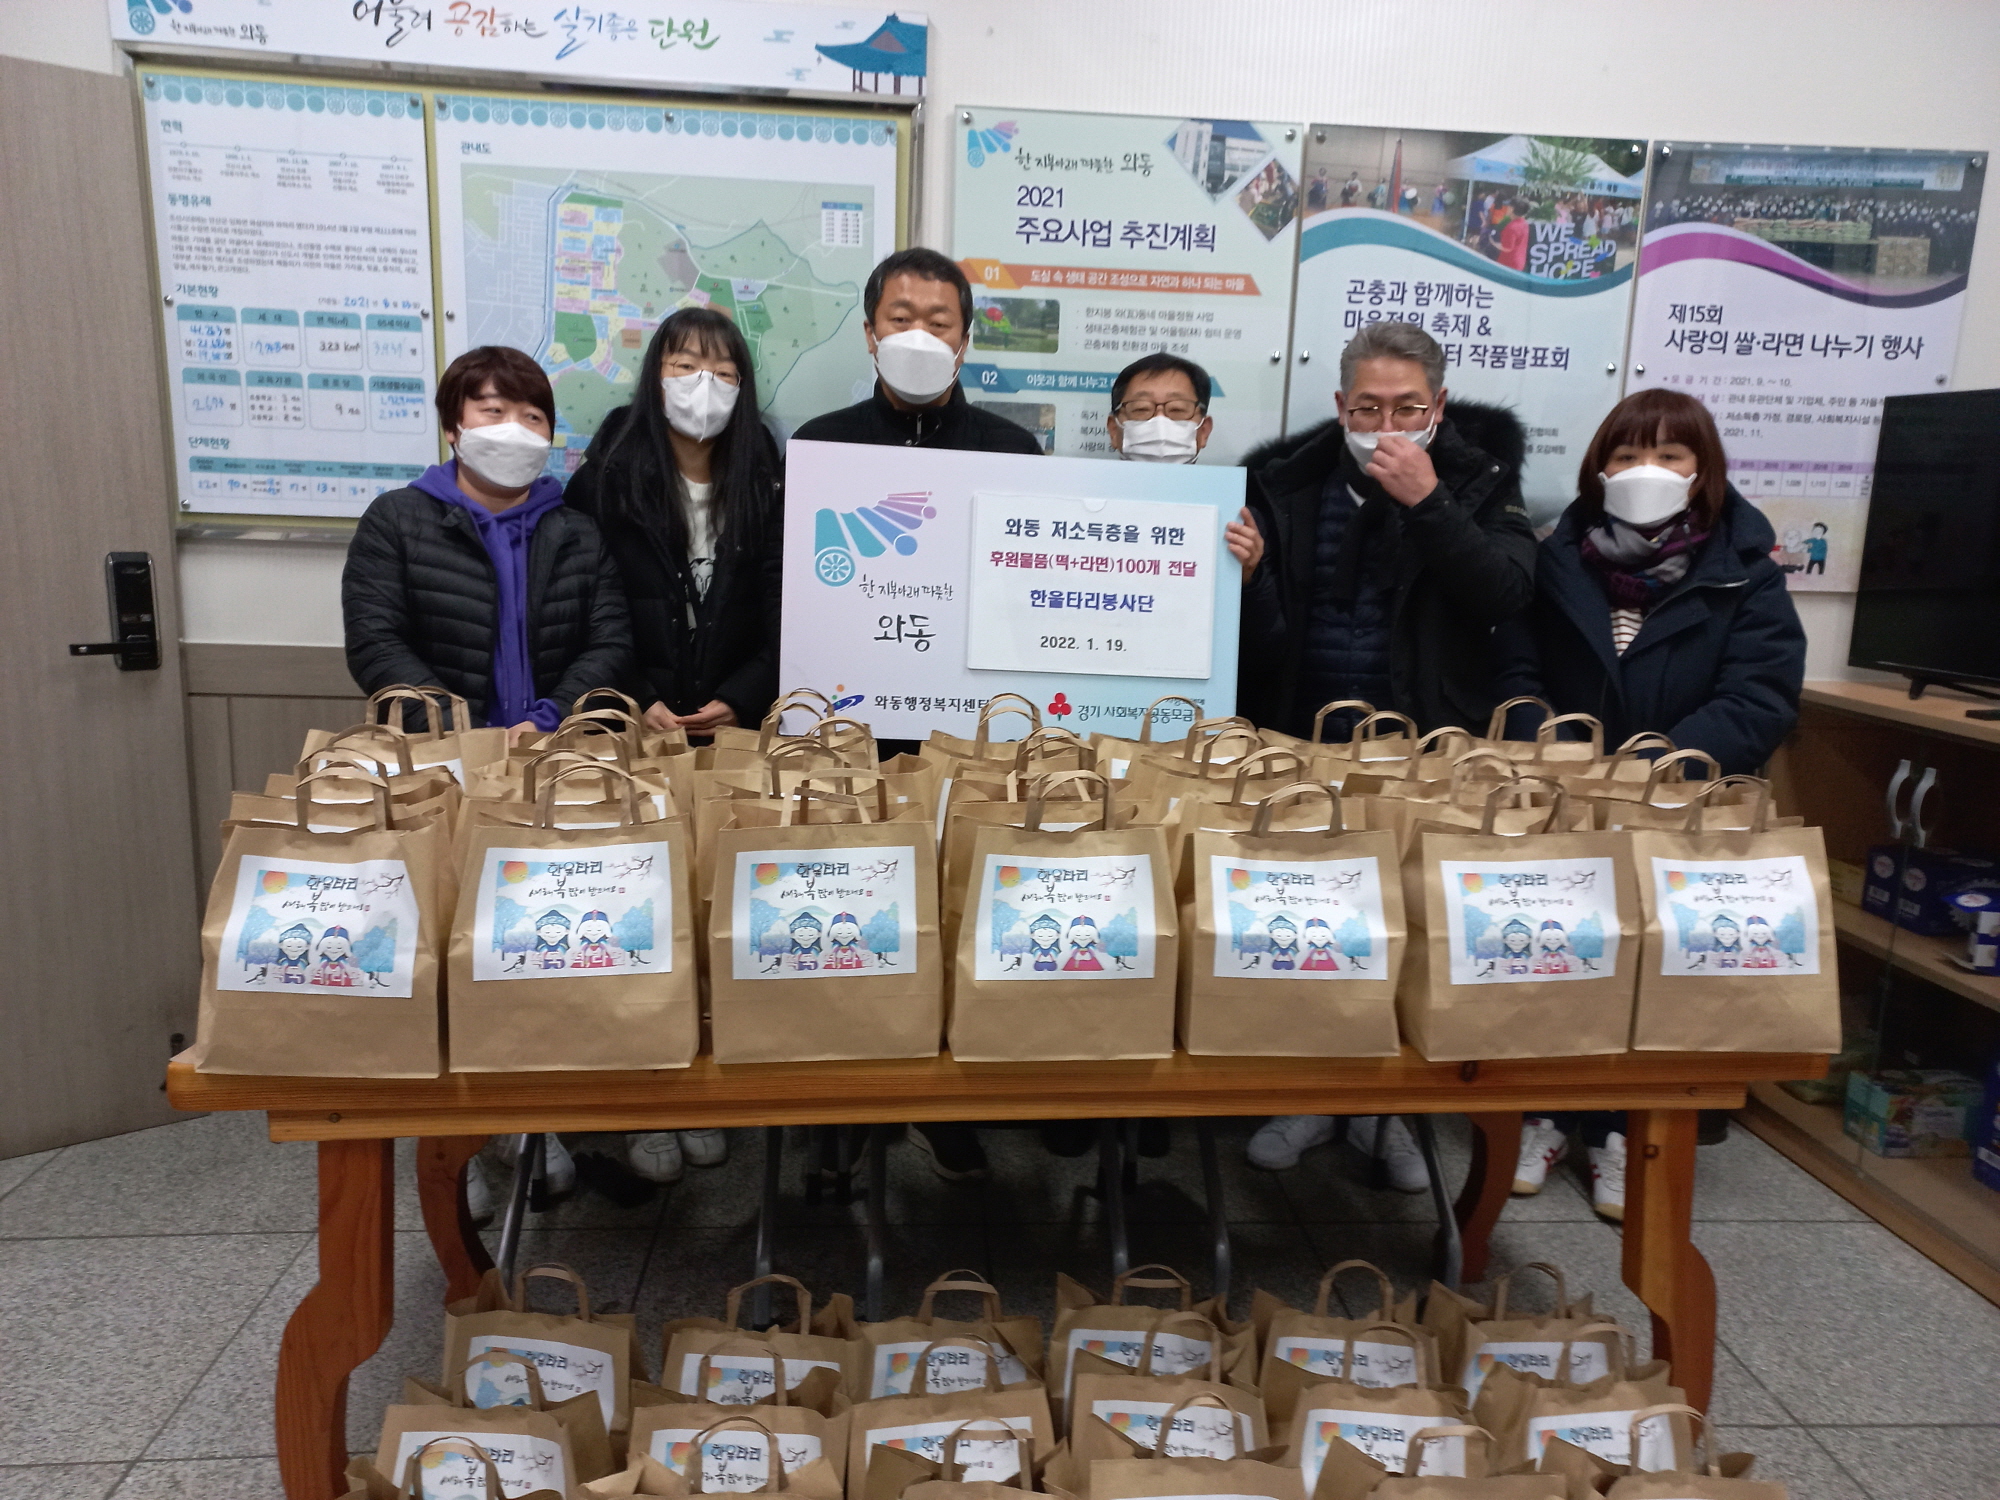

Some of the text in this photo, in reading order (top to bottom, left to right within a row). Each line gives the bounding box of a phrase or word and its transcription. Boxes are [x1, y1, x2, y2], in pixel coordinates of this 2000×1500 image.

[239, 24, 269, 45] 와동
[444, 1, 549, 38] 공감하는
[649, 16, 721, 50] 단원
[460, 141, 492, 155] 관내도
[1015, 147, 1031, 170] 한
[1120, 153, 1154, 177] 와동
[1016, 185, 1064, 208] 2021
[1015, 217, 1217, 252] 주요사업 추진계획
[1534, 222, 1576, 242] WE
[1529, 239, 1617, 266] SPREAD
[984, 266, 1000, 280] 01
[1530, 258, 1596, 280] HOPE
[175, 283, 218, 298] 기본현황
[1053, 270, 1064, 283] 속
[1066, 271, 1085, 284] 생태
[1088, 271, 1107, 285] 공간
[1109, 272, 1148, 287] 조성으로
[1150, 273, 1179, 288] 자연과
[1181, 274, 1201, 288] 하나
[1203, 275, 1223, 289] 되는
[1225, 276, 1245, 291] 마을
[1346, 279, 1494, 309] 곤충과 함께하는
[1158, 309, 1194, 322] 마을정원
[1196, 311, 1214, 323] 사업
[1668, 303, 1724, 325] 제15회
[1431, 312, 1472, 338] 축제
[1477, 315, 1492, 337] &
[1084, 339, 1120, 351] 곤충체험
[1122, 340, 1148, 352] 친환경
[1171, 342, 1190, 353] 조성
[1664, 329, 1728, 354] 사랑의
[1811, 333, 1875, 359] 나누기
[1881, 334, 1925, 361] 행사
[1468, 343, 1570, 371] 작품발표회
[981, 370, 998, 385] 02
[1026, 374, 1108, 388] 이웃과 함께 나누고
[1817, 415, 1871, 426] 사회복지시설
[188, 436, 230, 450] 단체현황
[1723, 428, 1748, 438] 2021.
[1005, 518, 1185, 546] 와동 저소득층을 위한
[1168, 560, 1197, 577] 전달
[859, 574, 875, 598] 한
[873, 614, 936, 652] 와동
[1040, 635, 1128, 652] 2022. 1. 19.
[1078, 704, 1100, 720] 경기
[547, 860, 602, 877] 한울타리
[796, 862, 849, 878] 한울타리
